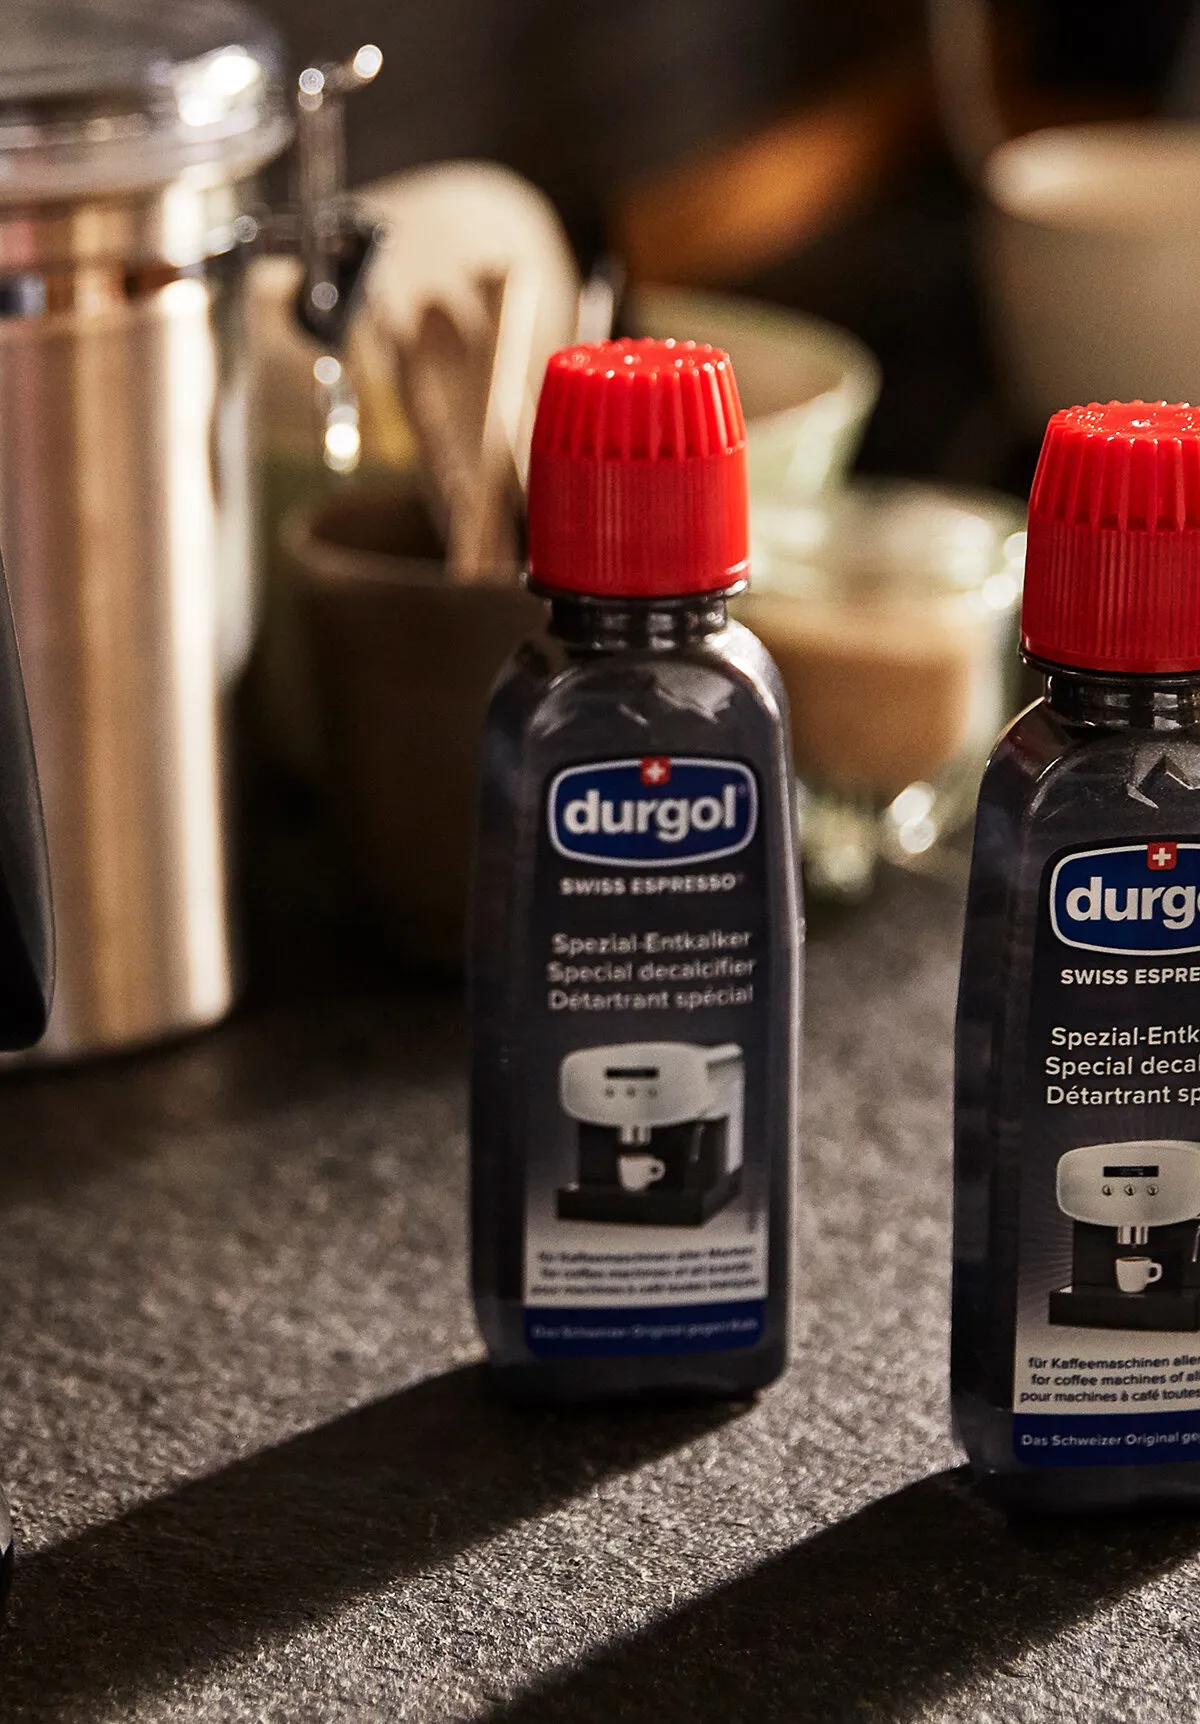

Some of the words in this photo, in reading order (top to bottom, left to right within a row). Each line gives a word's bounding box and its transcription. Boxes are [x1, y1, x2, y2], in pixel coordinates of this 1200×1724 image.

[563, 784, 737, 842] durgol
[560, 877, 626, 895] SWISS
[629, 872, 737, 894] ESPRESSO
[1060, 969, 1128, 985] SWISS
[1045, 1056, 1133, 1079] Special
[1046, 1085, 1171, 1105] Détartrant
[1051, 1356, 1170, 1369] Kaffeemaschinen
[1031, 1374, 1051, 1386] for
[1054, 1374, 1098, 1386] coffee
[1101, 1373, 1166, 1386] machines
[1169, 1371, 1184, 1383] of
[1020, 1391, 1051, 1403] pour
[1054, 1391, 1118, 1403] machines
[1021, 1434, 1048, 1446] Das
[1125, 1432, 1180, 1447] Original
